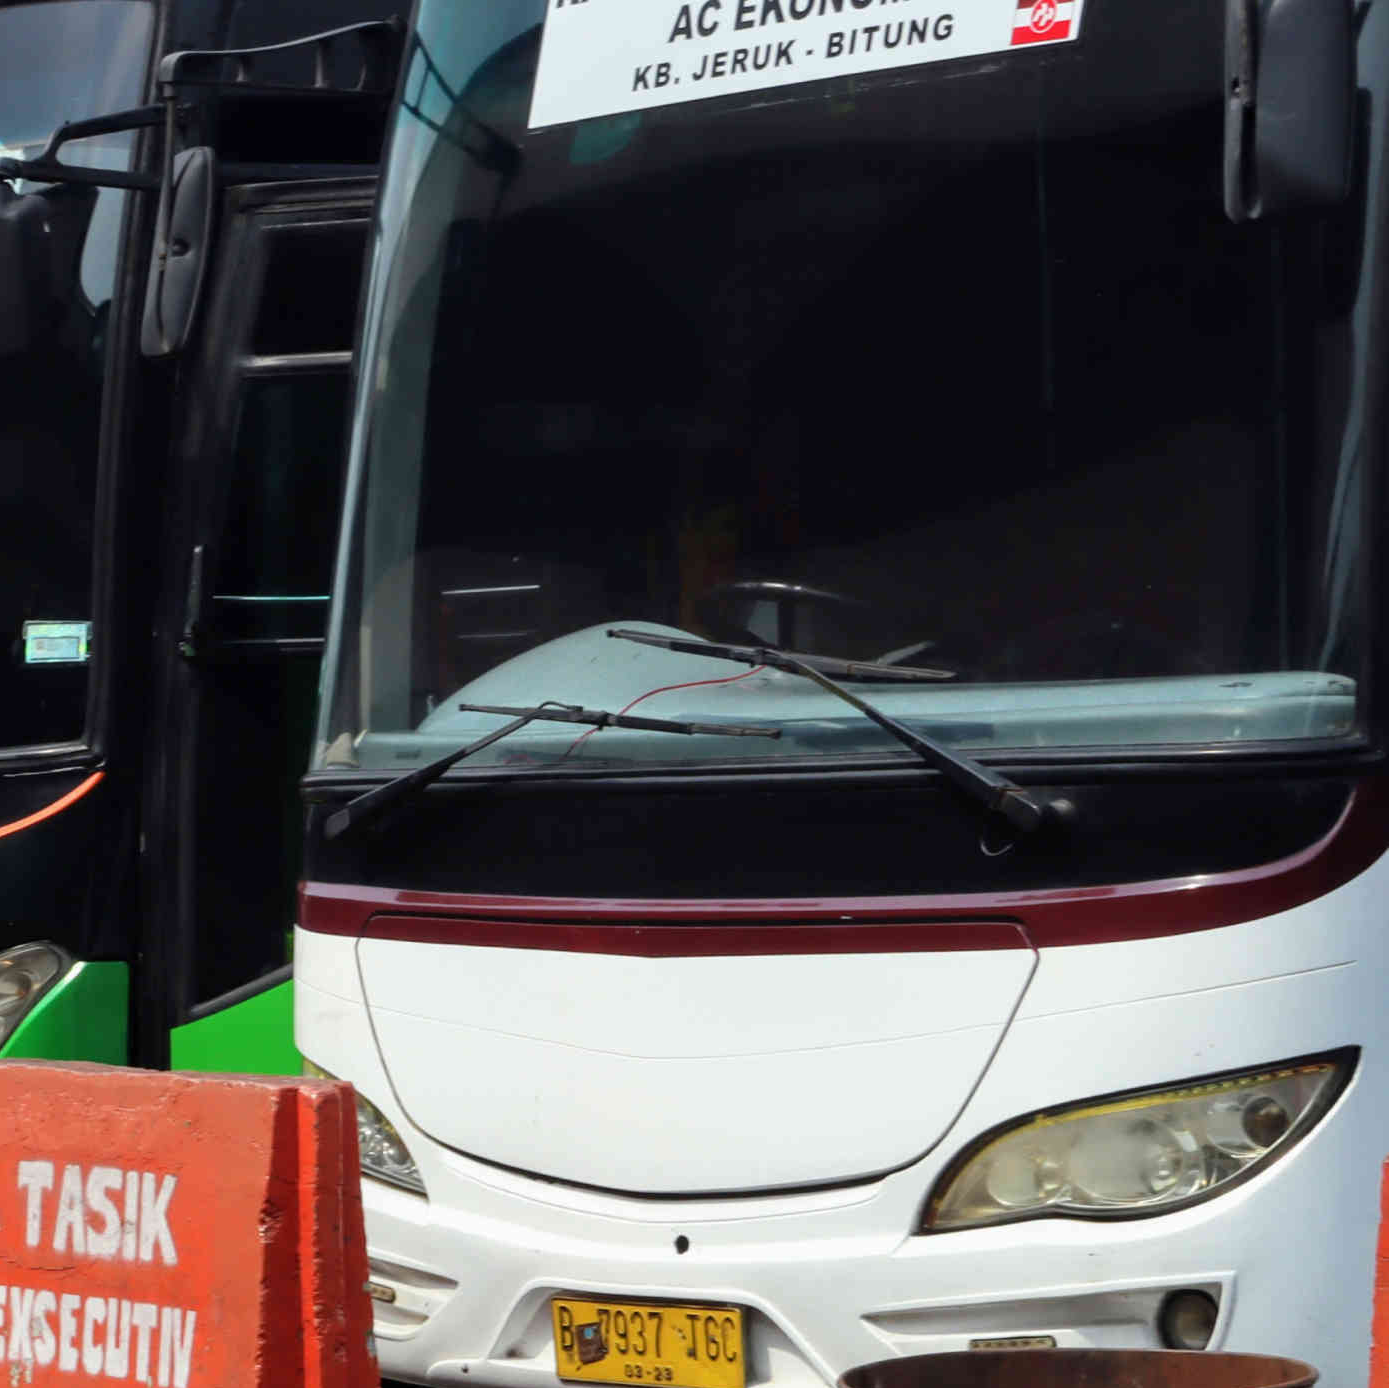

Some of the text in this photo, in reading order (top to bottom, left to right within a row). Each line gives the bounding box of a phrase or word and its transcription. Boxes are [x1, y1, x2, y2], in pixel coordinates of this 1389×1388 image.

[632, 66, 680, 91] KB.
[692, 40, 795, 80] JERUK
[826, 13, 954, 58] BITUNG
[669, 0, 721, 42] AC
[18, 1160, 178, 1265] TASIK
[559, 1305, 573, 1351] B
